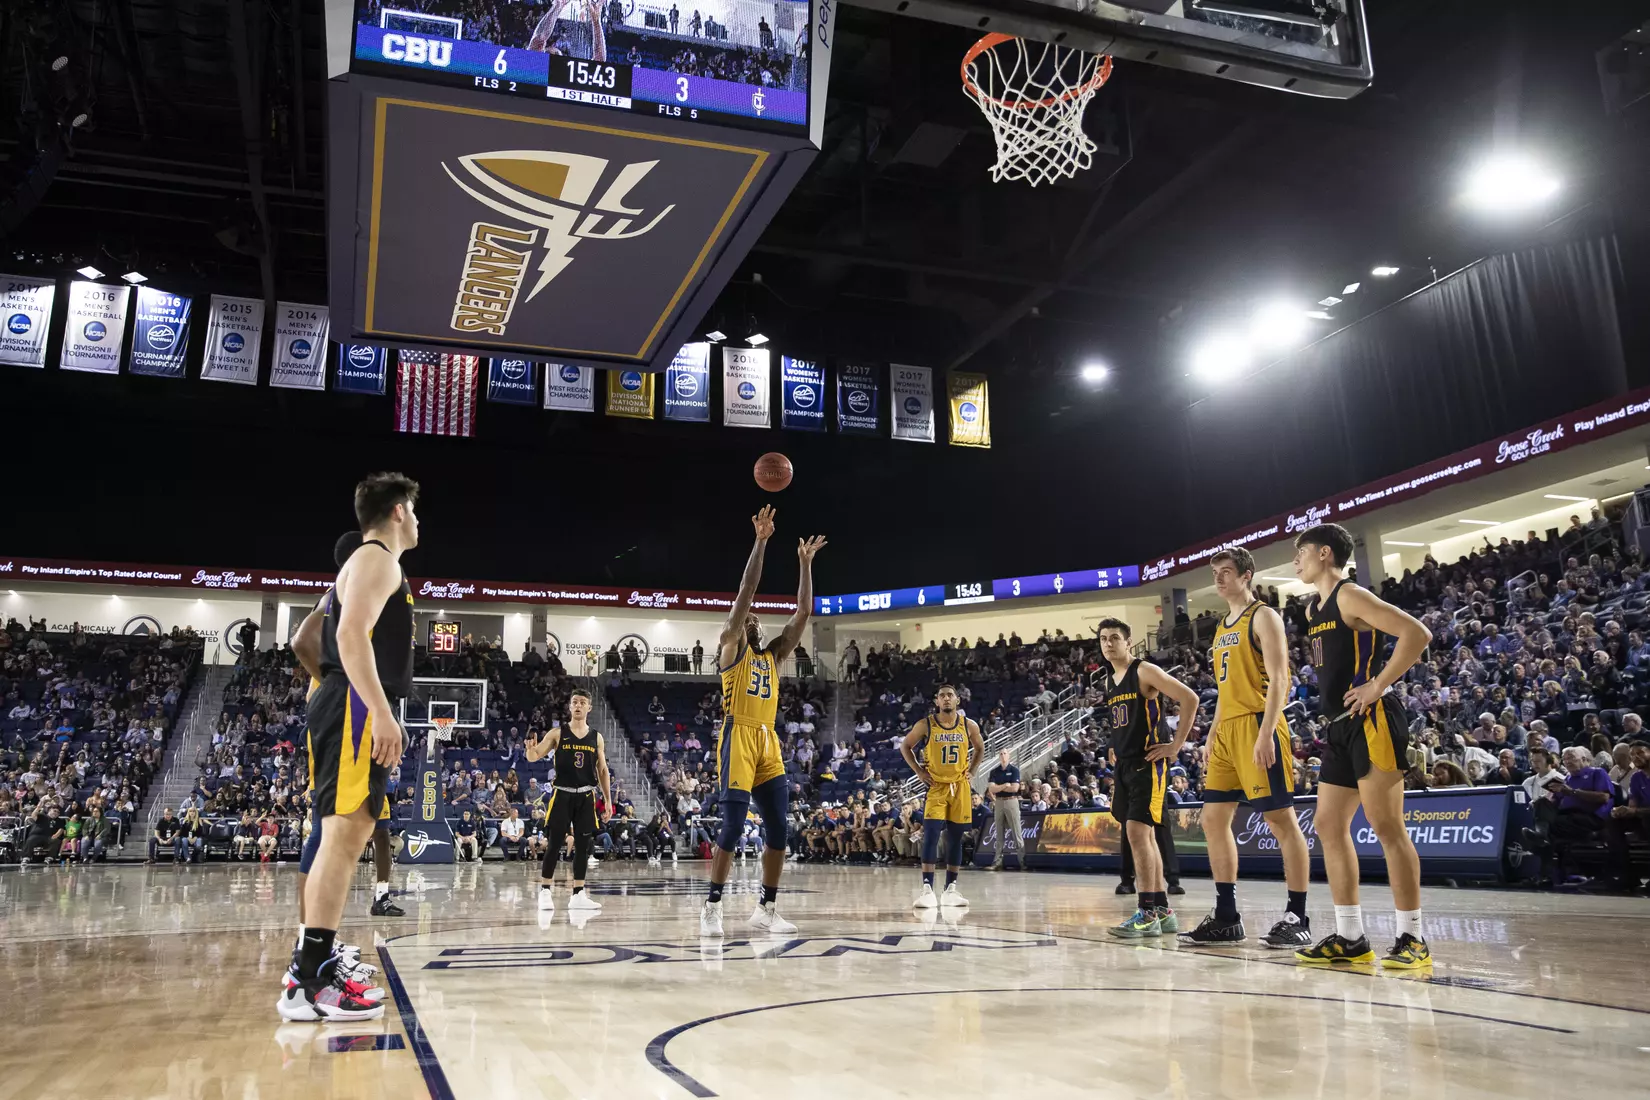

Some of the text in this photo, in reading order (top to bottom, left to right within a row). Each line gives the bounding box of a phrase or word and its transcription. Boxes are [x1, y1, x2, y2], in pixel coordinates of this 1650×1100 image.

[381, 33, 453, 67] CBU
[493, 49, 507, 75] 6
[567, 59, 616, 89] 15:43
[475, 76, 517, 91] FLS 2
[675, 77, 689, 101] 3
[561, 89, 622, 106] 1ST HALF
[659, 104, 698, 119] FLS 5
[450, 222, 538, 335] LANCERS
[8, 282, 40, 293] 2017
[84, 290, 115, 302] 2016
[149, 307, 176, 315] MEN'S
[221, 302, 252, 314] 2015
[222, 315, 248, 323] MEN'S
[287, 310, 317, 320] 2014
[211, 322, 260, 332] BASKETBALL
[277, 328, 325, 338] BASKETBALL
[73, 344, 106, 353] DIVISION
[224, 341, 243, 349] NCAA
[65, 350, 117, 360] TOURNAMENT
[133, 351, 184, 362] TOURNAMENT
[209, 355, 245, 364] DIVISION
[211, 363, 239, 372] SWEET
[281, 361, 312, 370] DIVISION
[791, 359, 816, 369] 2017
[274, 367, 323, 377] TOURNAMENT
[337, 369, 383, 379] CHAMPIONS
[786, 368, 819, 377] WOMEN'S
[846, 365, 871, 375] 2017
[784, 375, 824, 385] BASKETBALL
[842, 375, 873, 383] WOMEN'S
[900, 371, 923, 381] 2017
[490, 380, 535, 390] CHAMPIONS
[621, 379, 641, 387] NCAA
[896, 382, 926, 390] WOMEN'S
[566, 386, 591, 394] REGION
[549, 391, 589, 400] CHAMPIONS
[611, 392, 643, 400] DIVISION
[611, 399, 648, 407] NATIONAL
[665, 399, 707, 407] CHAMPIONS
[609, 405, 640, 413] RUNNER
[726, 409, 768, 417] TOURNAMENT
[784, 409, 824, 418] CHAMPIONS
[840, 414, 878, 423] TOURNAMENT
[1574, 407, 1626, 433] Play Inland
[842, 420, 876, 429] CHAMPIONS
[1495, 423, 1564, 464] Goose Creek
[1511, 442, 1550, 461] GOLF CLUB
[1338, 457, 1481, 511] Book TeeTimes at www.goosecreekgc.com
[22, 565, 39, 575] Play
[40, 566, 63, 574] Inland
[64, 568, 96, 577] Empire's
[98, 569, 112, 577] Top
[114, 570, 135, 578] Rated
[137, 571, 152, 579] Golf
[153, 572, 181, 580] Course!
[192, 569, 252, 585] Goose Creek
[261, 577, 279, 585] Book
[281, 578, 314, 586] TeeTimes
[419, 580, 475, 595] Goose Creek
[955, 582, 982, 598] 15:43
[1012, 579, 1021, 596] 3
[482, 587, 497, 596] Play
[518, 590, 546, 599] Empire's
[547, 591, 560, 599] Top
[594, 593, 619, 601] Course!
[627, 591, 679, 605] Goose Creek
[918, 589, 925, 605] 6
[686, 597, 701, 605] Book
[703, 598, 731, 606] TeeTimes
[858, 592, 891, 611] CBU
[434, 624, 458, 634] 15:43
[434, 634, 454, 651] 30
[1219, 651, 1230, 683] 5
[746, 670, 772, 699] 35
[1112, 703, 1129, 729] 30
[935, 733, 963, 742] LANCERS
[574, 751, 585, 768] 3
[941, 744, 959, 765] 15
[422, 770, 437, 821] CBU
[1412, 809, 1457, 823] Sponsor
[1458, 808, 1471, 820] of
[1406, 825, 1494, 844] THLETICS
